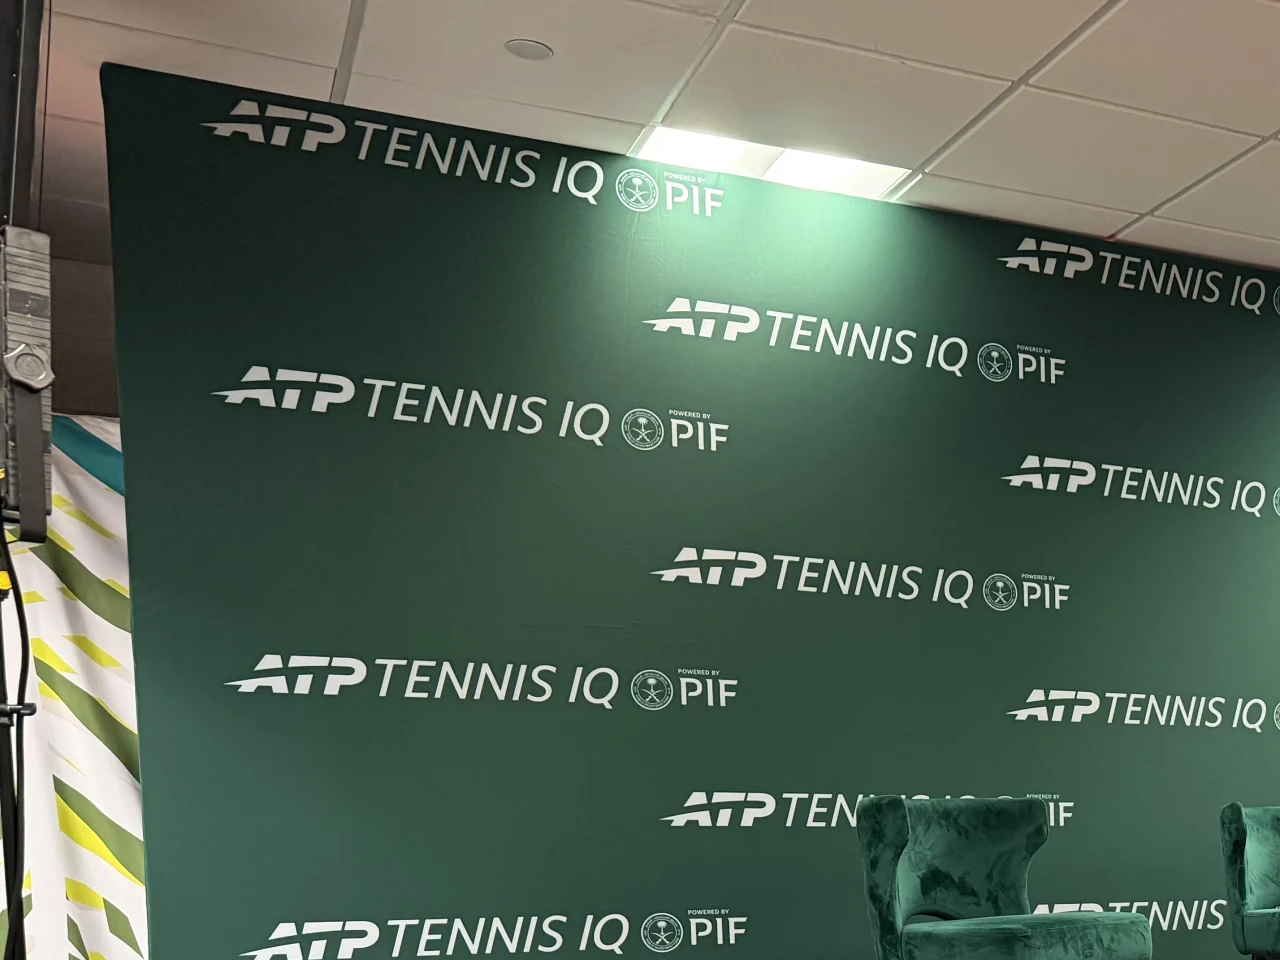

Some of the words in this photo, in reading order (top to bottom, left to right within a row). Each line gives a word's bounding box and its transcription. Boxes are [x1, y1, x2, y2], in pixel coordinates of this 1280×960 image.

[201, 101, 346, 151] ATP
[355, 122, 540, 187] TENNIS
[552, 158, 603, 205] IQ
[666, 182, 723, 216] PIF
[998, 238, 1093, 278] ATP
[1099, 252, 1223, 302] TENNIS
[1231, 276, 1265, 315] IQ
[642, 298, 759, 341] ATP
[767, 311, 916, 364] TENNIS
[926, 335, 968, 377] IQ
[1018, 353, 1065, 384] PIF
[1017, 344, 1043, 353] POWERED
[211, 366, 355, 412] ATP
[363, 378, 547, 434] TENNIS
[559, 401, 609, 446] IQ
[670, 419, 729, 451] PIF
[669, 409, 701, 418] POWERED
[1001, 455, 1096, 492] ATP
[1101, 464, 1224, 508] TENNIS
[1231, 480, 1265, 517] IQ
[650, 547, 766, 586] ATP
[773, 555, 922, 599] TENNIS
[932, 569, 973, 608] IQ
[1023, 582, 1070, 609] PIF
[224, 654, 367, 695] ATP
[375, 659, 556, 702] TENNIS
[569, 667, 619, 709] IQ
[680, 678, 738, 706] PIF
[1006, 689, 1100, 722] ATP
[1105, 693, 1225, 727] TENNIS
[1232, 698, 1266, 732] IQ
[659, 792, 776, 827] ATP
[1049, 802, 1074, 826] IF
[387, 915, 567, 957] TENNIS
[579, 914, 629, 954] IQ
[689, 917, 747, 945] PIF
